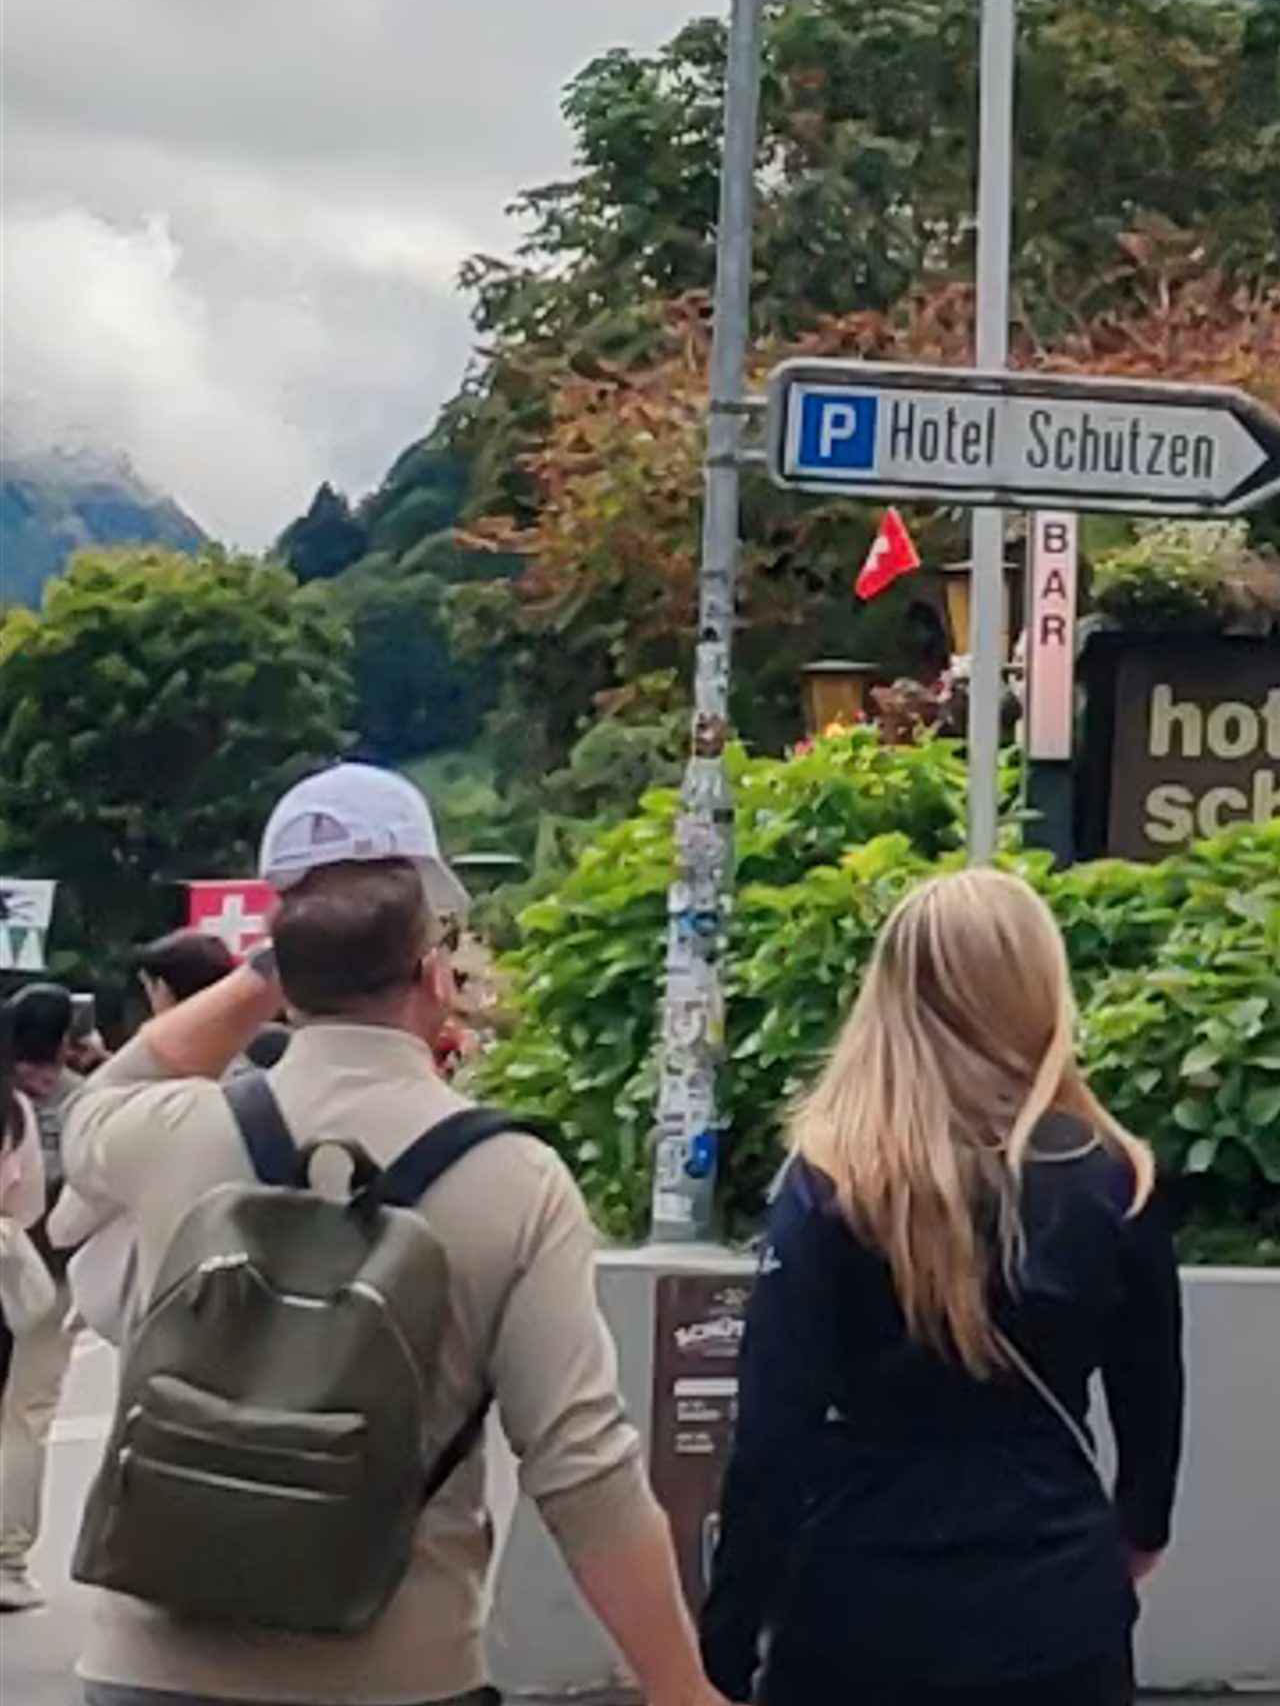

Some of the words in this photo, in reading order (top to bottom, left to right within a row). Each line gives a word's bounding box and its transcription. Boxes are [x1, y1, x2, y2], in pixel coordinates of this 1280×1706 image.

[819, 404, 856, 458] P
[890, 401, 996, 467] Hotel
[1026, 410, 1213, 479] Schützen
[1041, 523, 1068, 646] BAR
